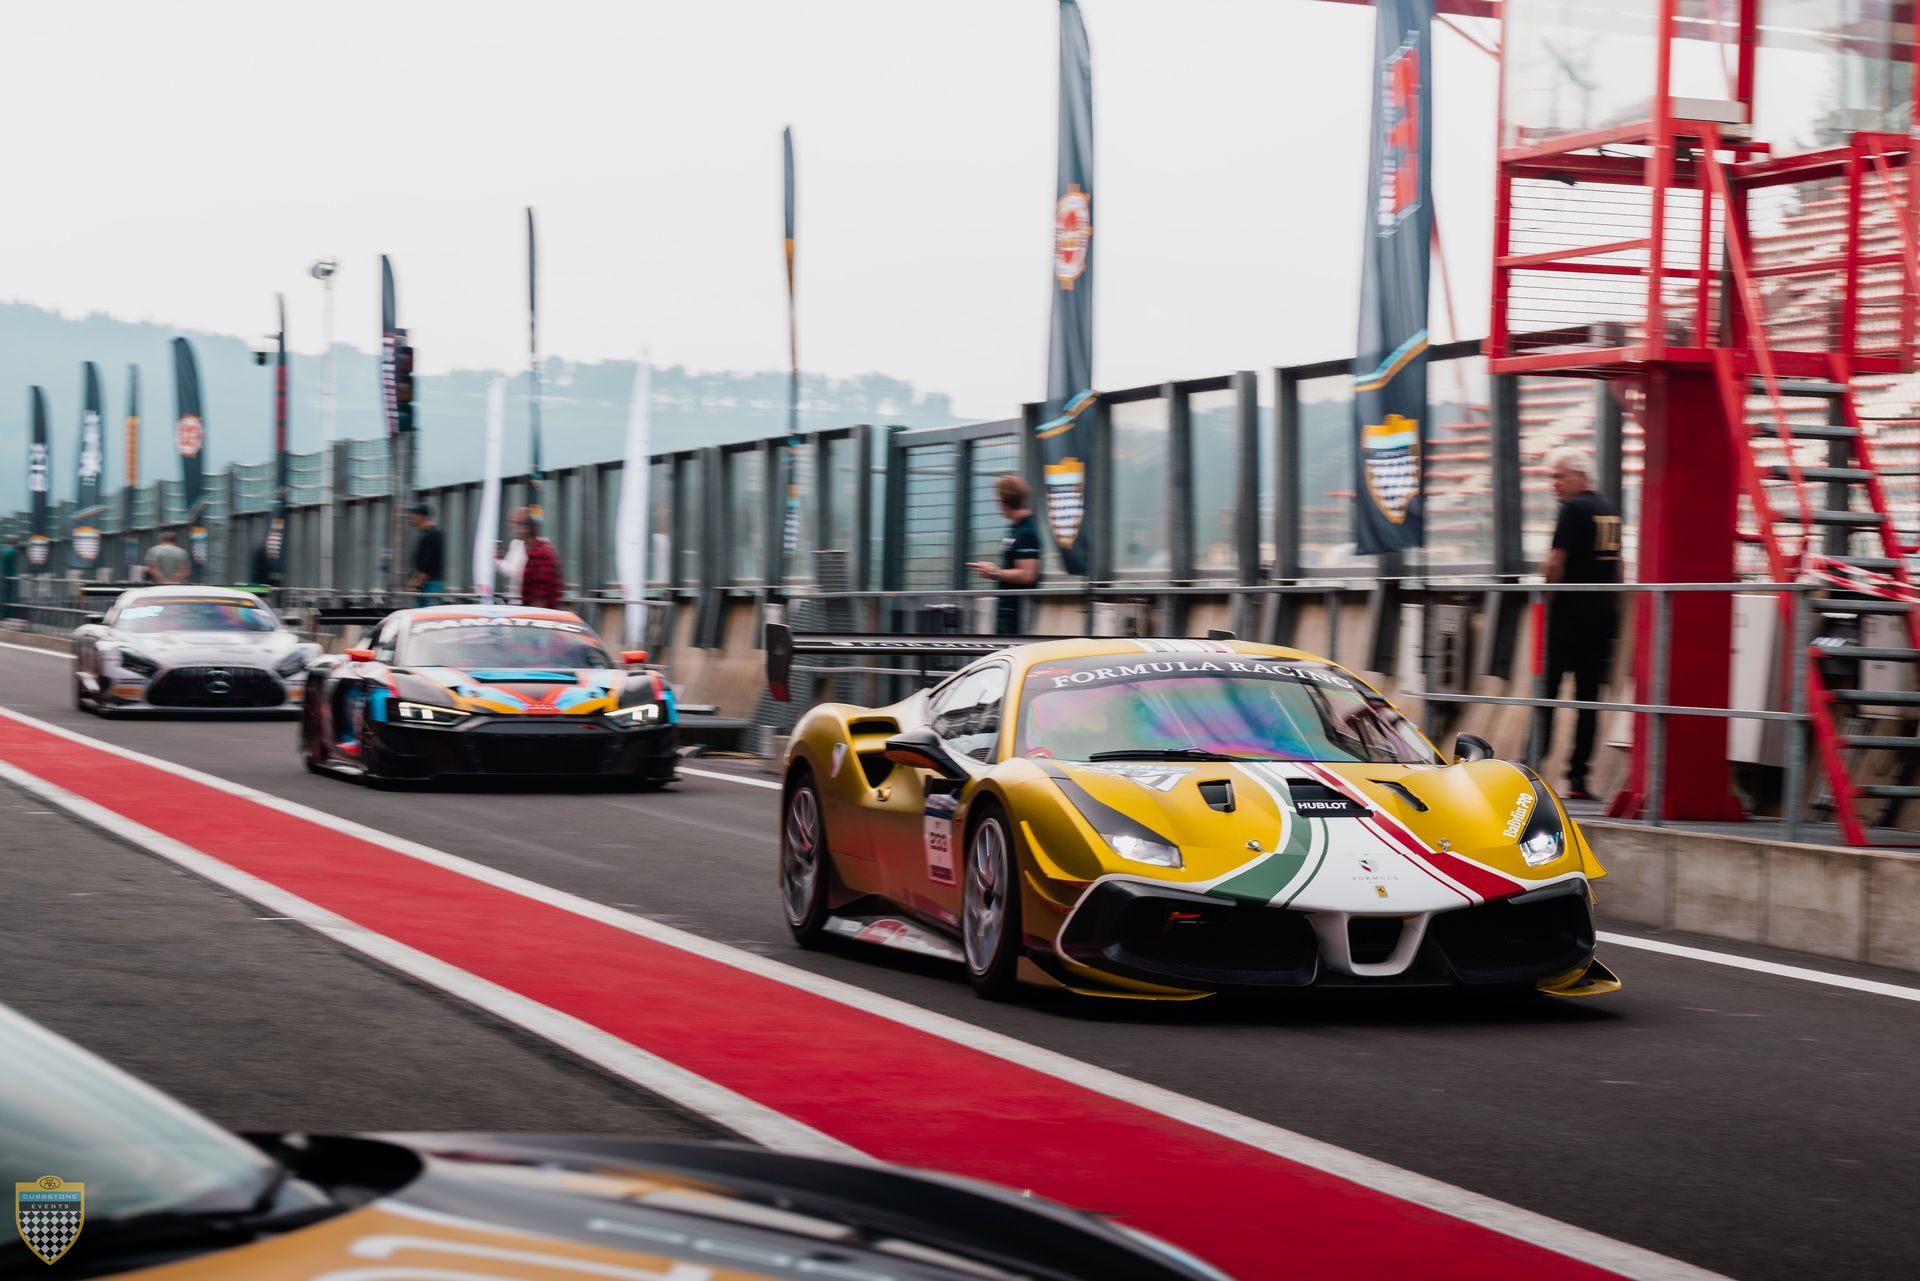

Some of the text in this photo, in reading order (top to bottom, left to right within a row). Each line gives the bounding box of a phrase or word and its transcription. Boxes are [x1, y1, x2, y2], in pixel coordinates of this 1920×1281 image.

[1051, 660, 1355, 689] FORMULA RACING
[1296, 802, 1347, 810] HUBLOT
